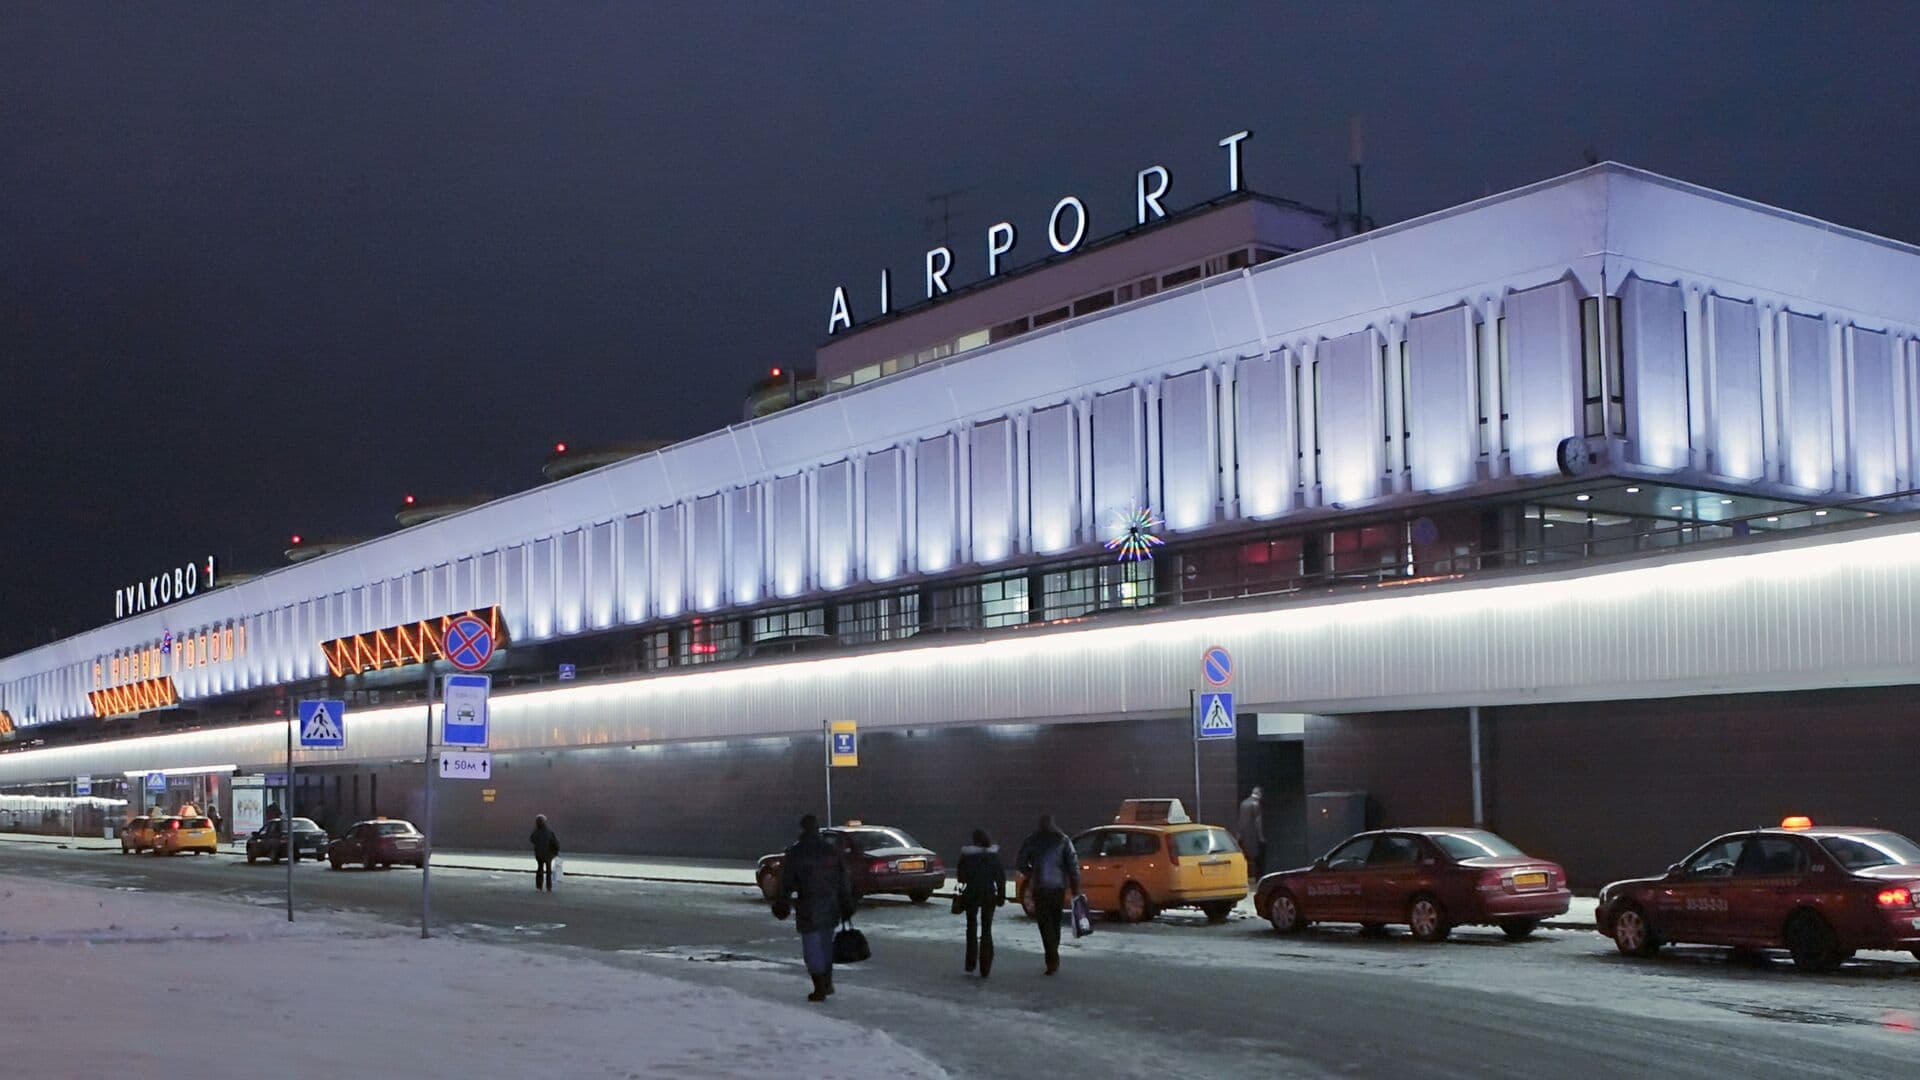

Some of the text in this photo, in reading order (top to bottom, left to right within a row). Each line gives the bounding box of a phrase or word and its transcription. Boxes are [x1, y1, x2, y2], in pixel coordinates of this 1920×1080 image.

[828, 130, 1249, 335] AIRPORT
[115, 555, 214, 619] ПУЛКОВО 1
